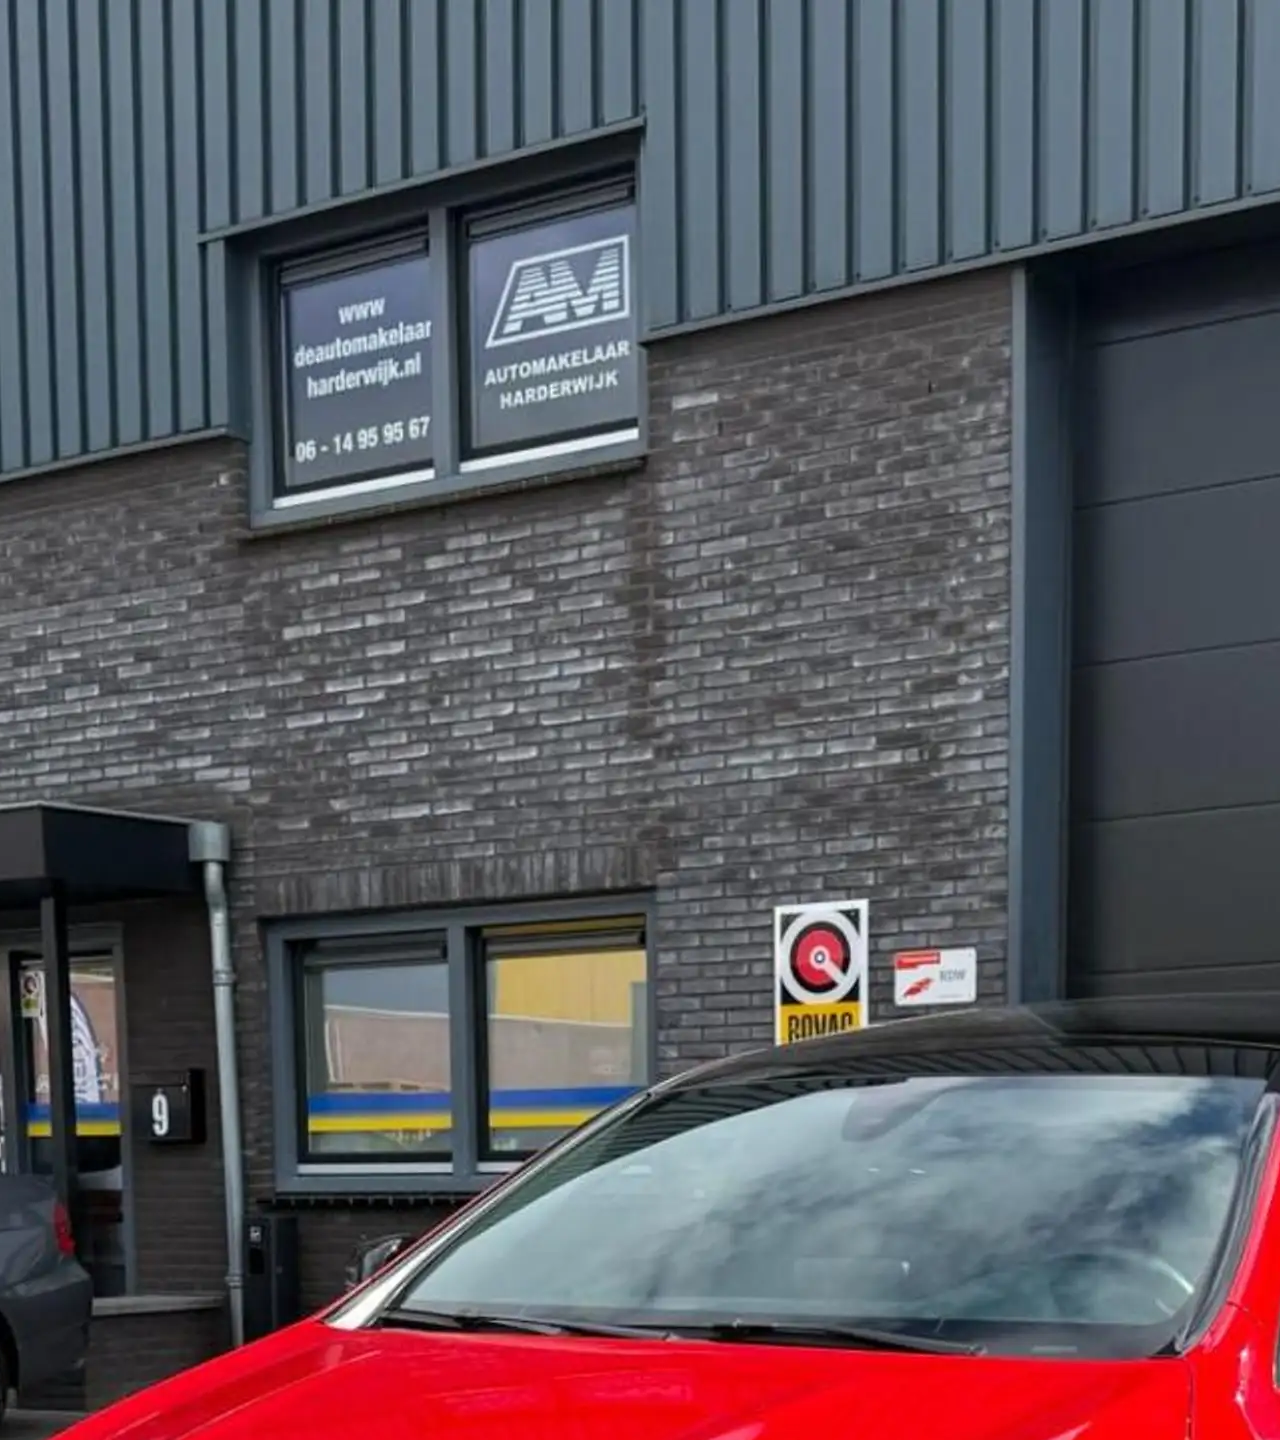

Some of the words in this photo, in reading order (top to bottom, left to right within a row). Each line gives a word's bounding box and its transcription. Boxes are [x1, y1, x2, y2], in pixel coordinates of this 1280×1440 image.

[338, 297, 386, 325] www
[293, 319, 432, 369] deautomakelaar
[484, 339, 631, 387] AUTOMAKELAAR
[306, 350, 422, 400] harderwijk.nl
[499, 369, 620, 410] HARDERWIJK
[295, 439, 317, 463] 06
[333, 432, 353, 455] 14
[356, 425, 378, 450] 95
[383, 420, 404, 445] 95
[408, 415, 431, 440] 67
[151, 1093, 169, 1136] 9
